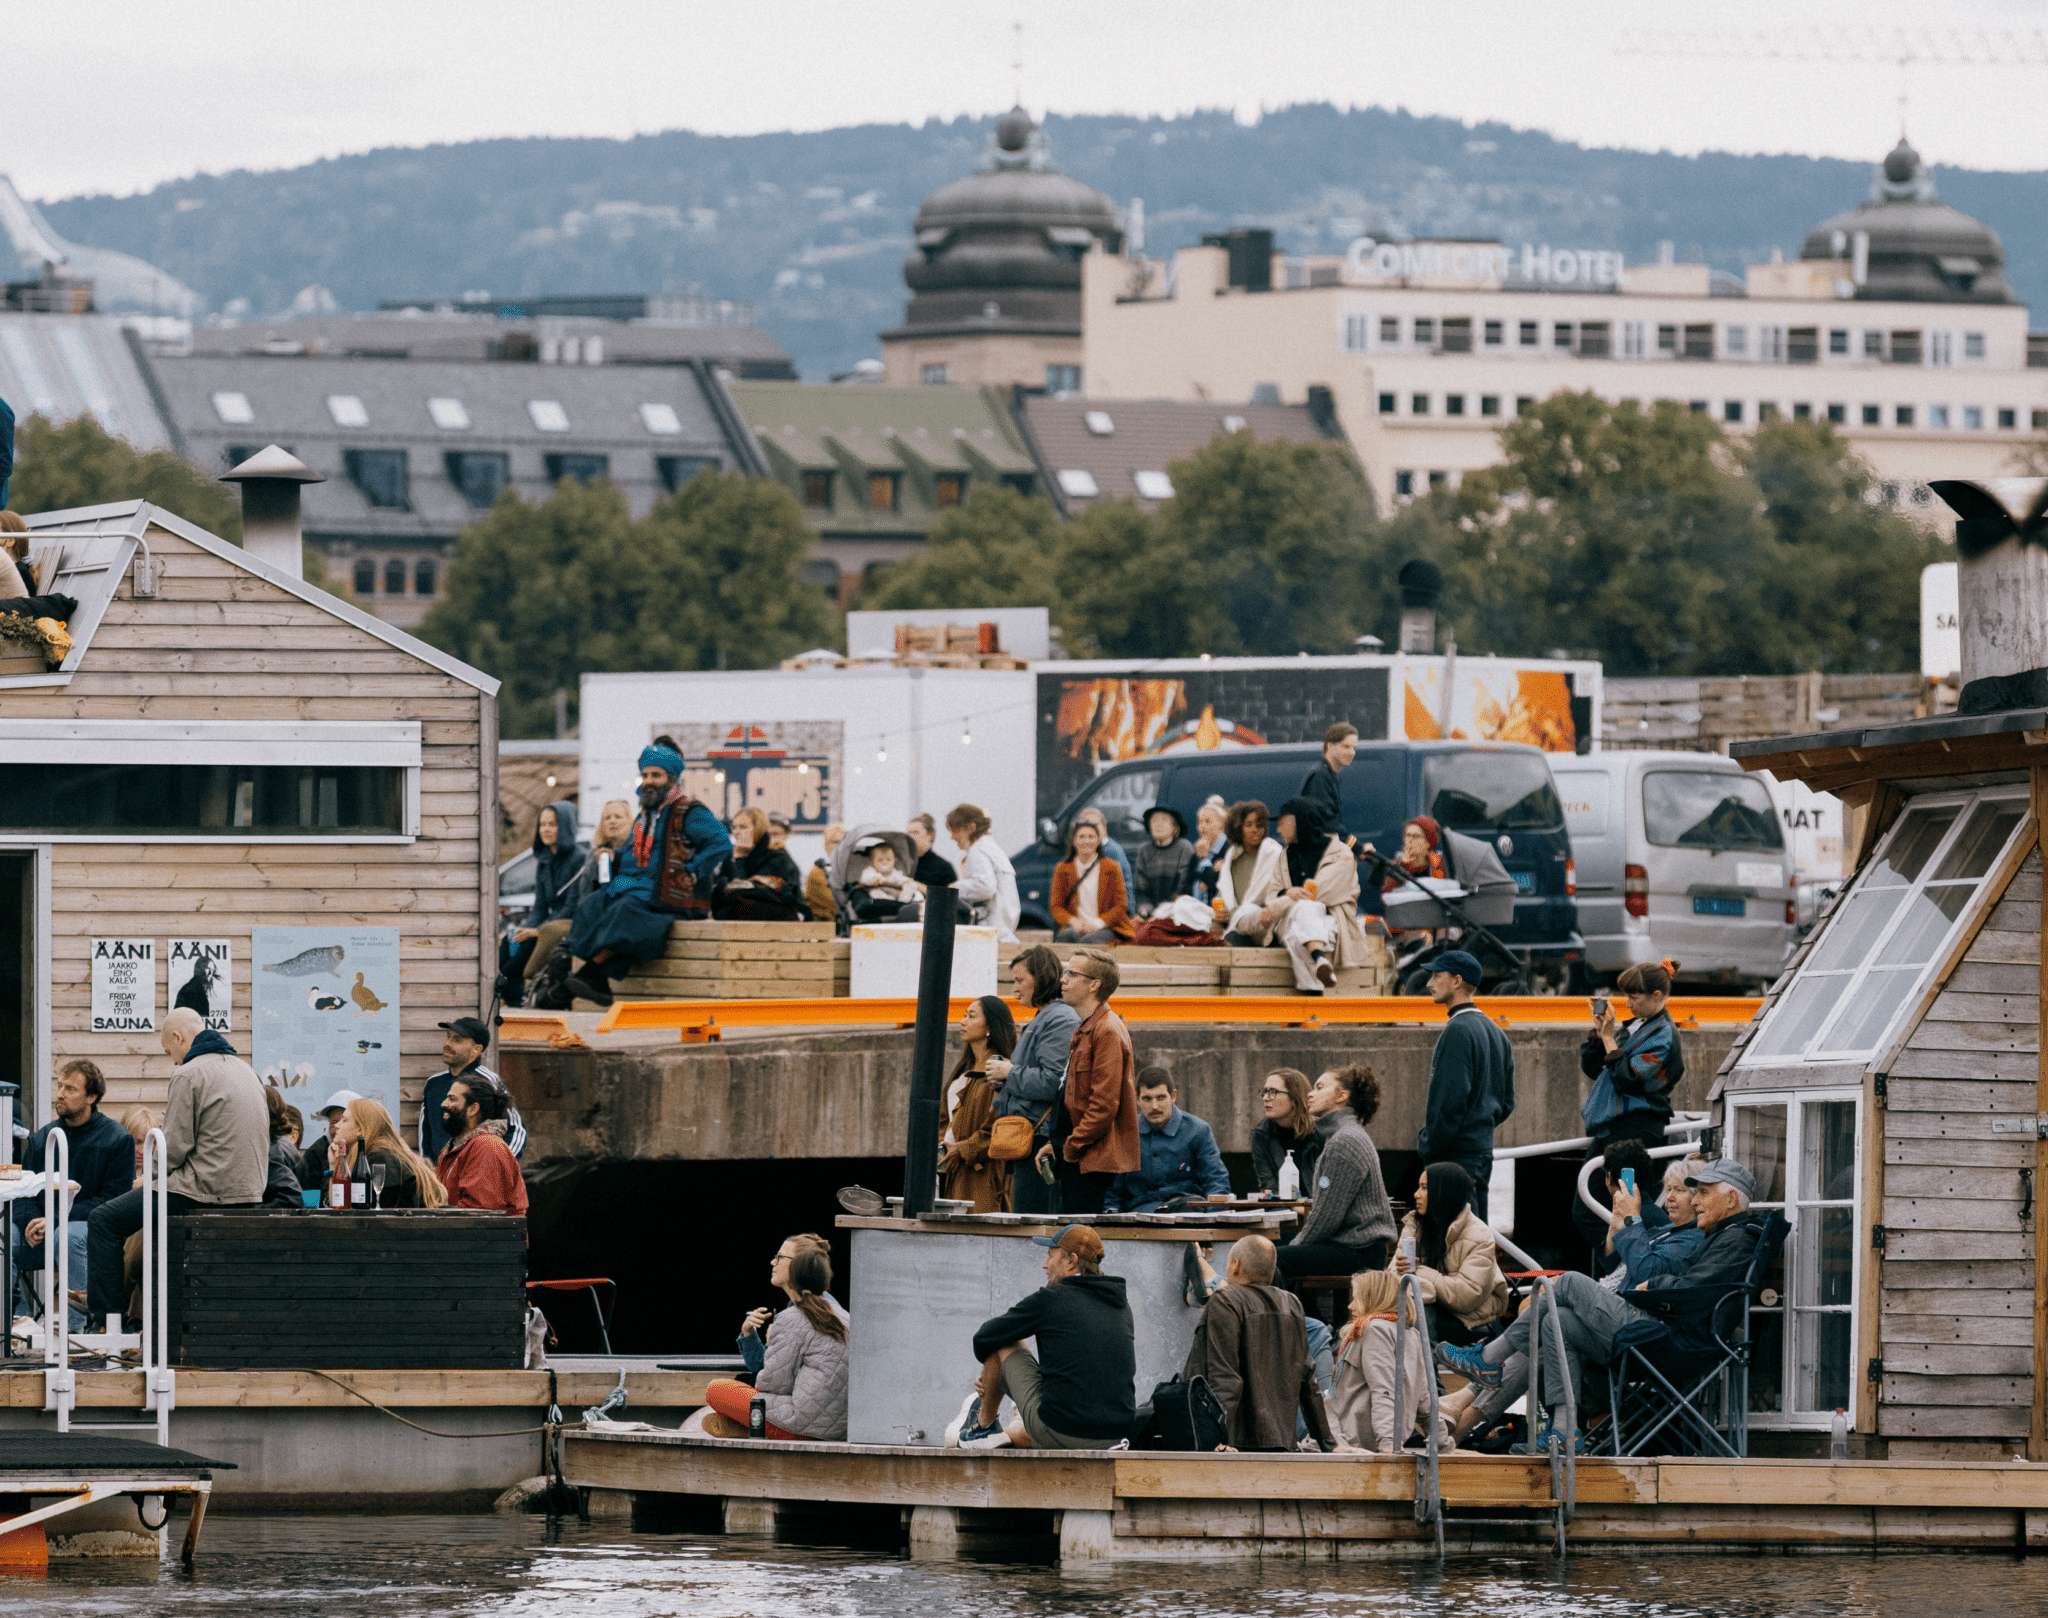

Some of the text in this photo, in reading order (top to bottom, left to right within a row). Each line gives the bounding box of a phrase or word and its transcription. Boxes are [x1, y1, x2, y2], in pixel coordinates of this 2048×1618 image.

[95, 941, 151, 959] ÄÄNI
[171, 941, 227, 960] ÄÄNI
[113, 969, 132, 977] EINO
[93, 1017, 152, 1029] SAUNA
